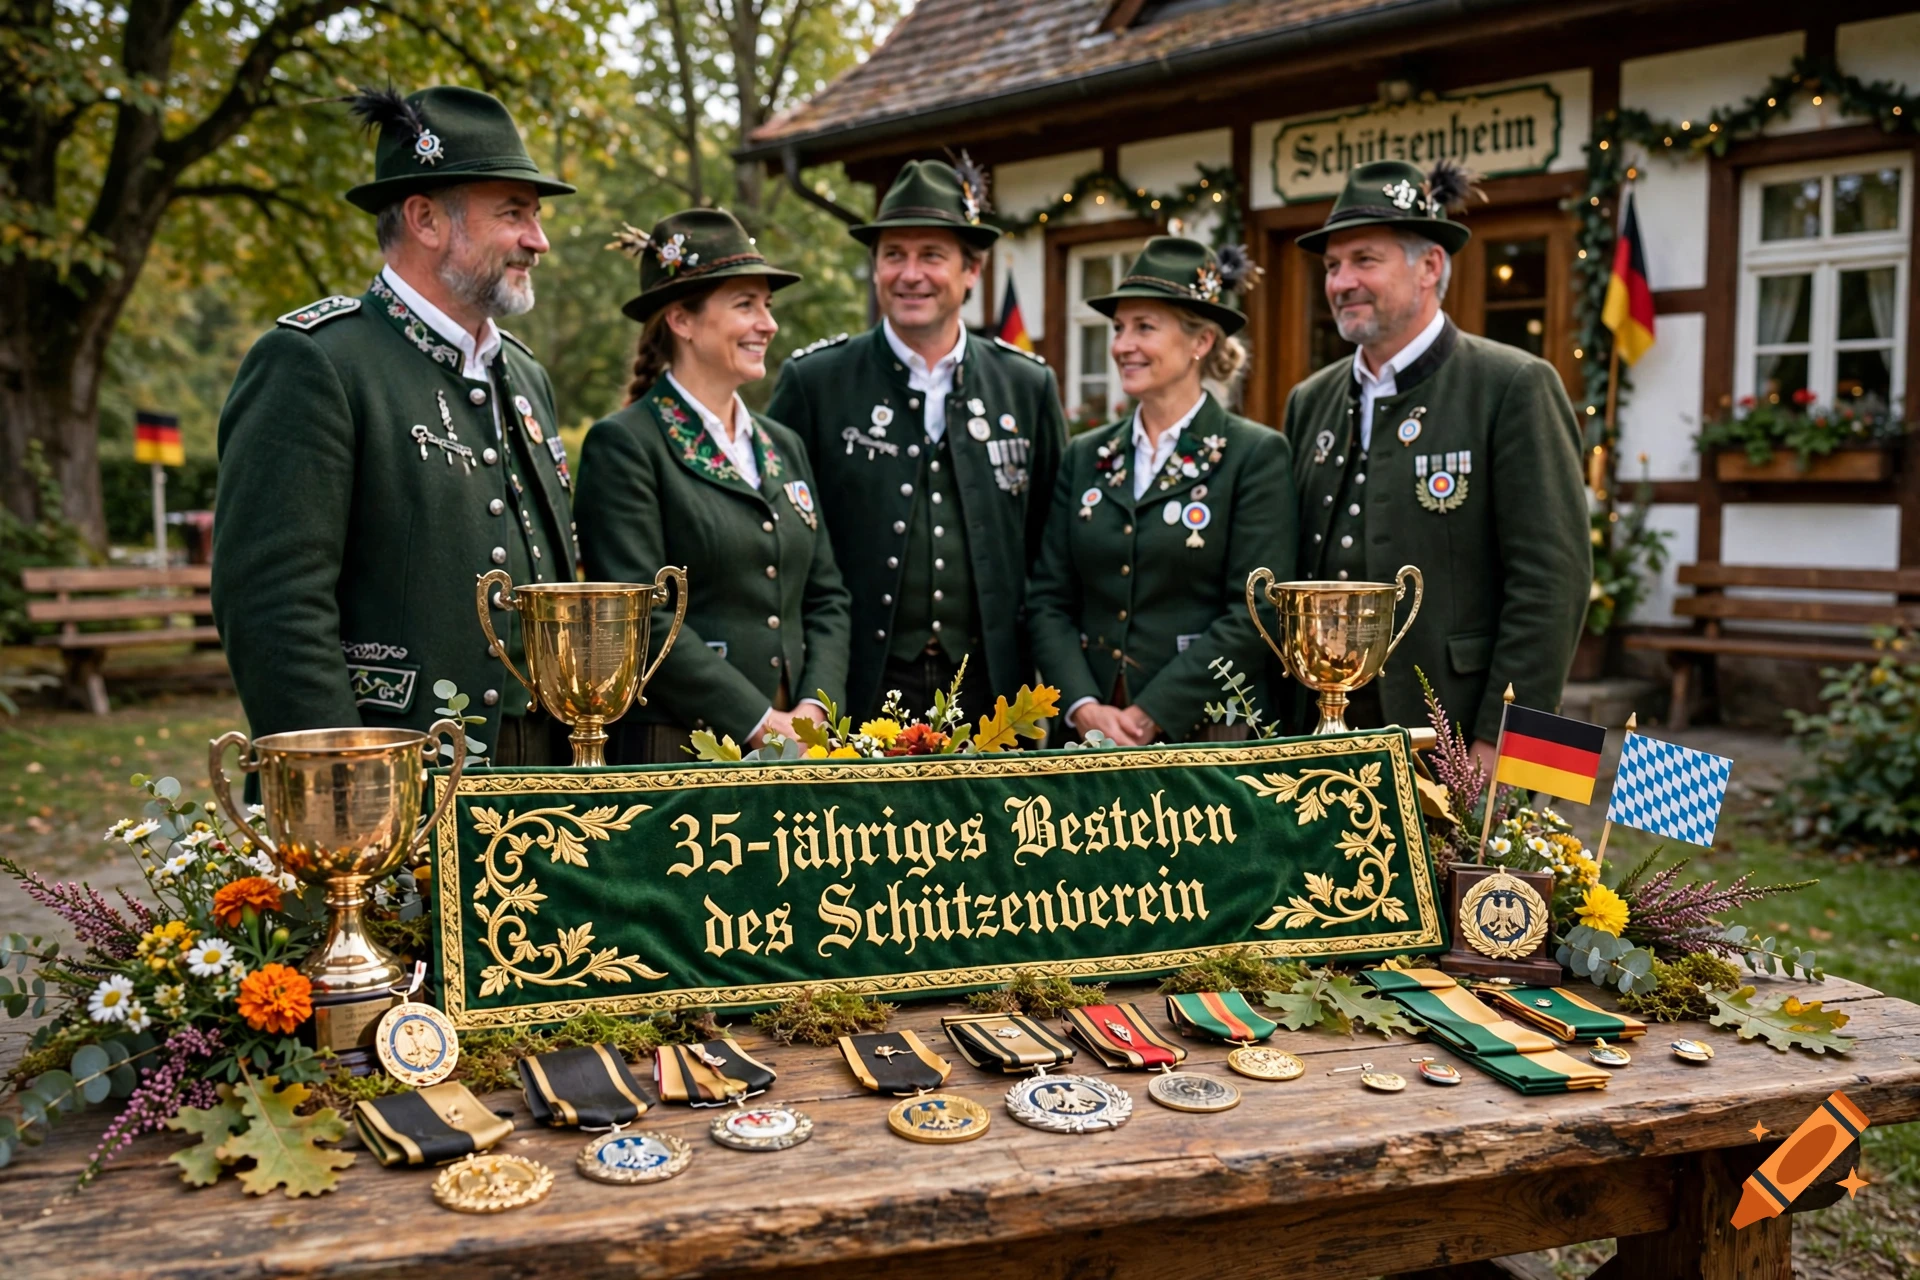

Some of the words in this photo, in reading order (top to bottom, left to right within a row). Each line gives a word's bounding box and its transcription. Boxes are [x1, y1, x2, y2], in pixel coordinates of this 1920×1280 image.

[1292, 107, 1536, 181] Schützenheim
[666, 805, 988, 887] 35-jähriges
[1003, 788, 1238, 867] Bestehen
[704, 894, 794, 958] des
[817, 865, 1210, 957] Schützenverein
